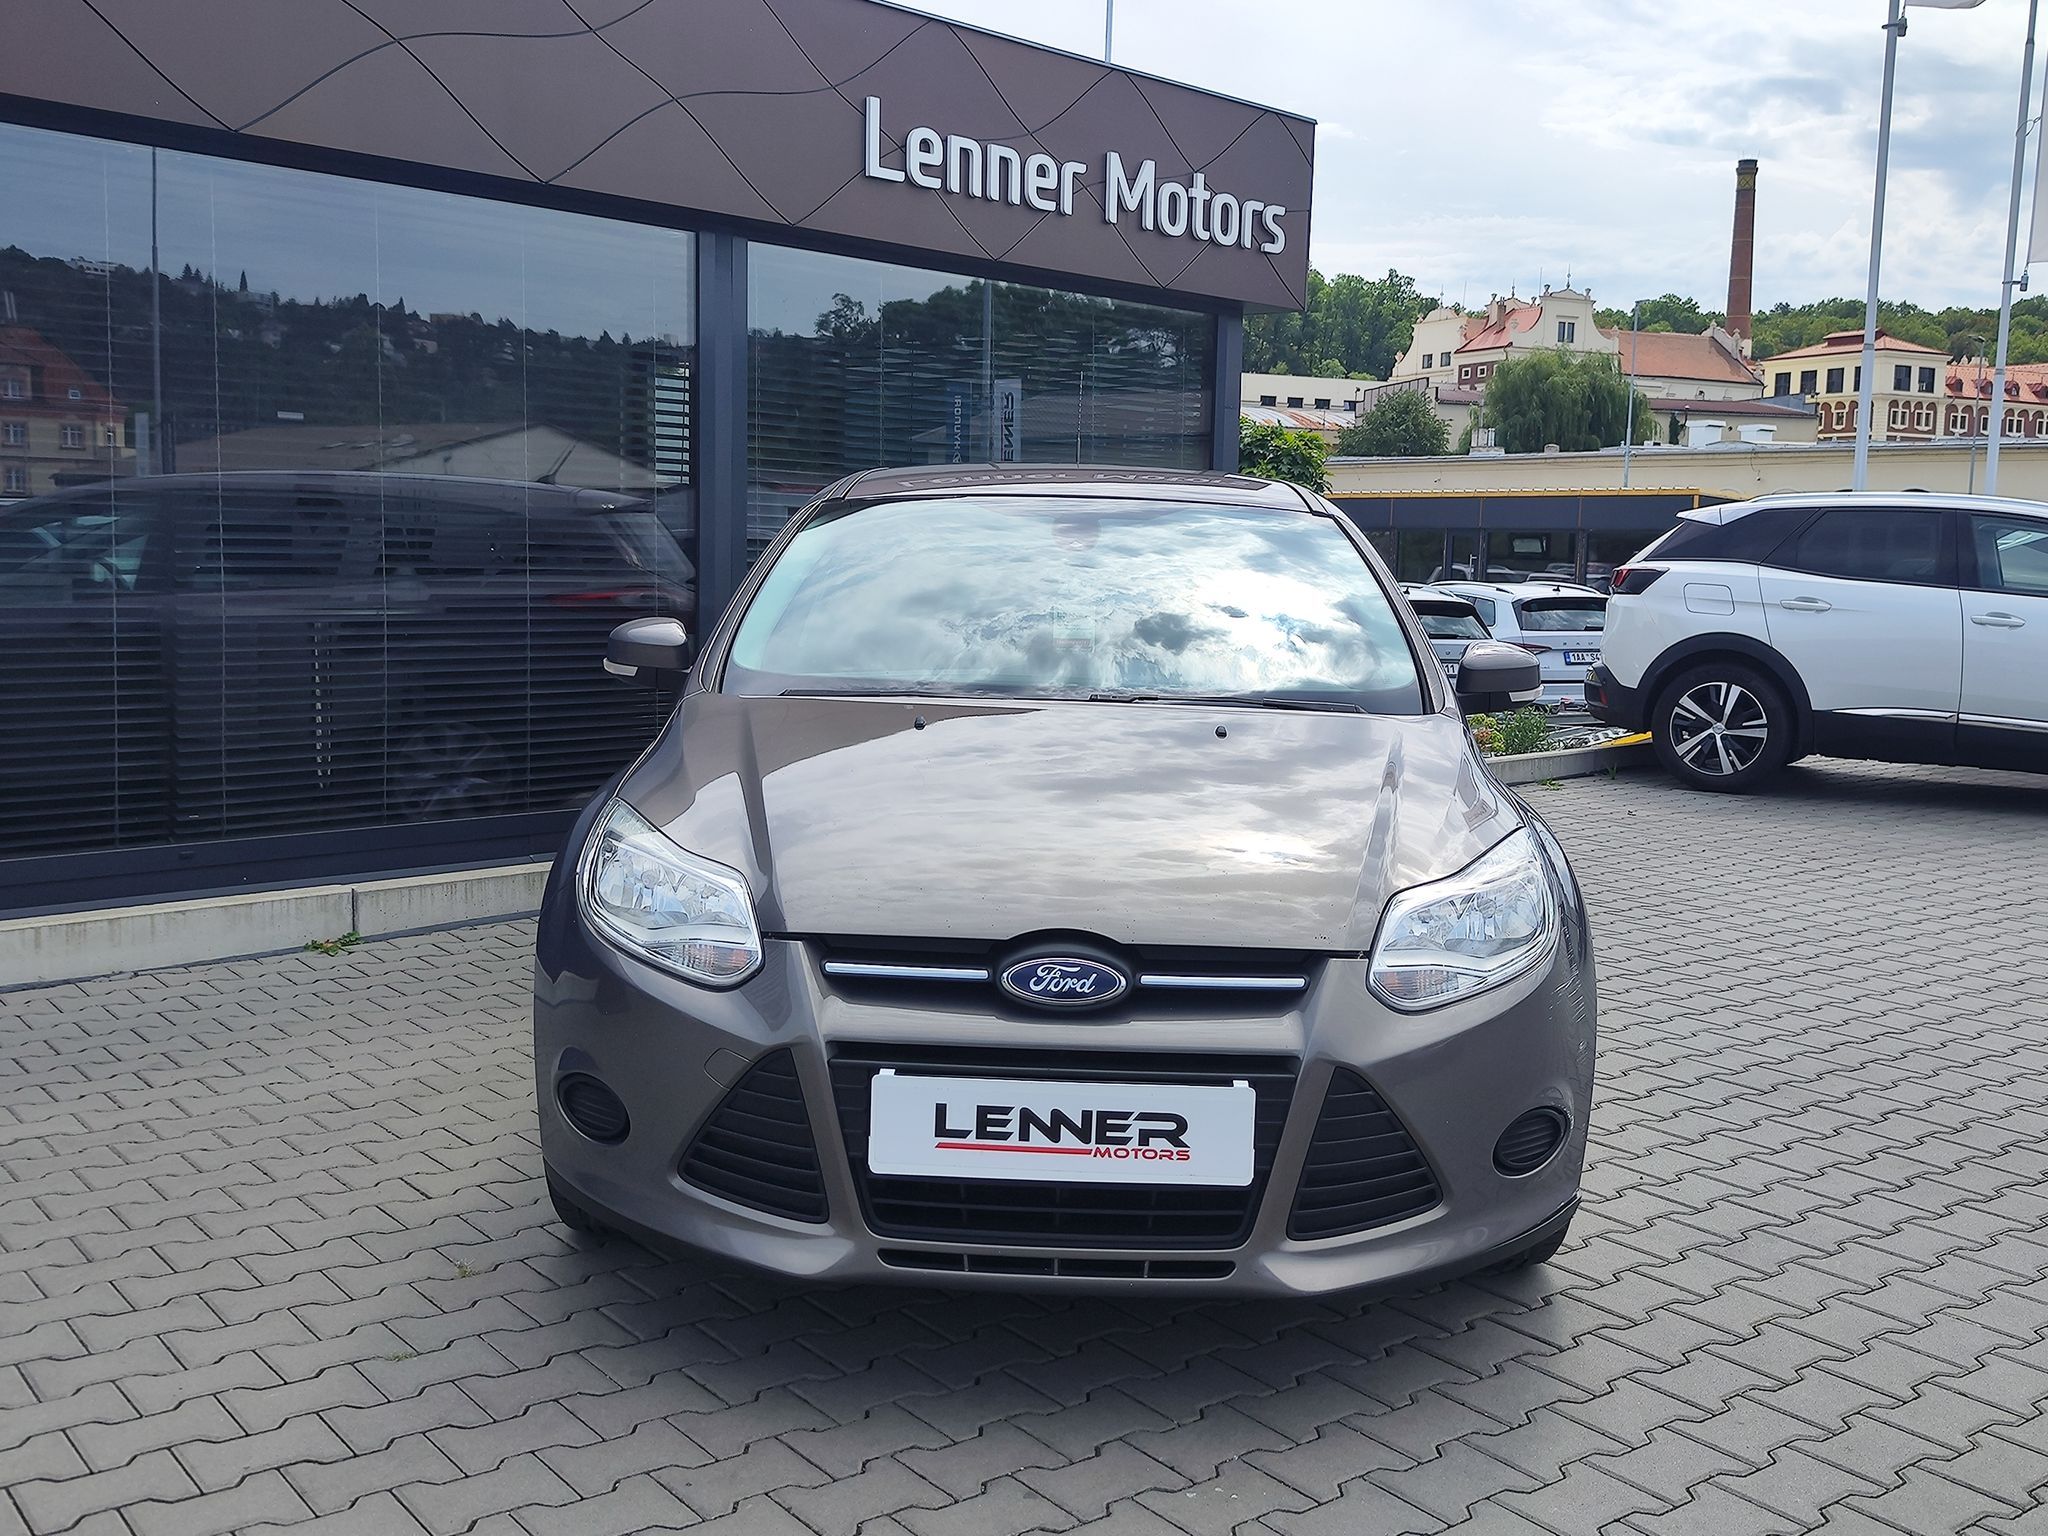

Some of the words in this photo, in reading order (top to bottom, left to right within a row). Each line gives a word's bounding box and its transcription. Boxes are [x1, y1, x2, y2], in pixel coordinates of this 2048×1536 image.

[865, 95, 1088, 216] Lenner
[1105, 151, 1287, 254] Motors
[1029, 964, 1098, 993] Ford
[934, 1102, 1191, 1148] LENNER
[1093, 1146, 1191, 1161] MOTORS
